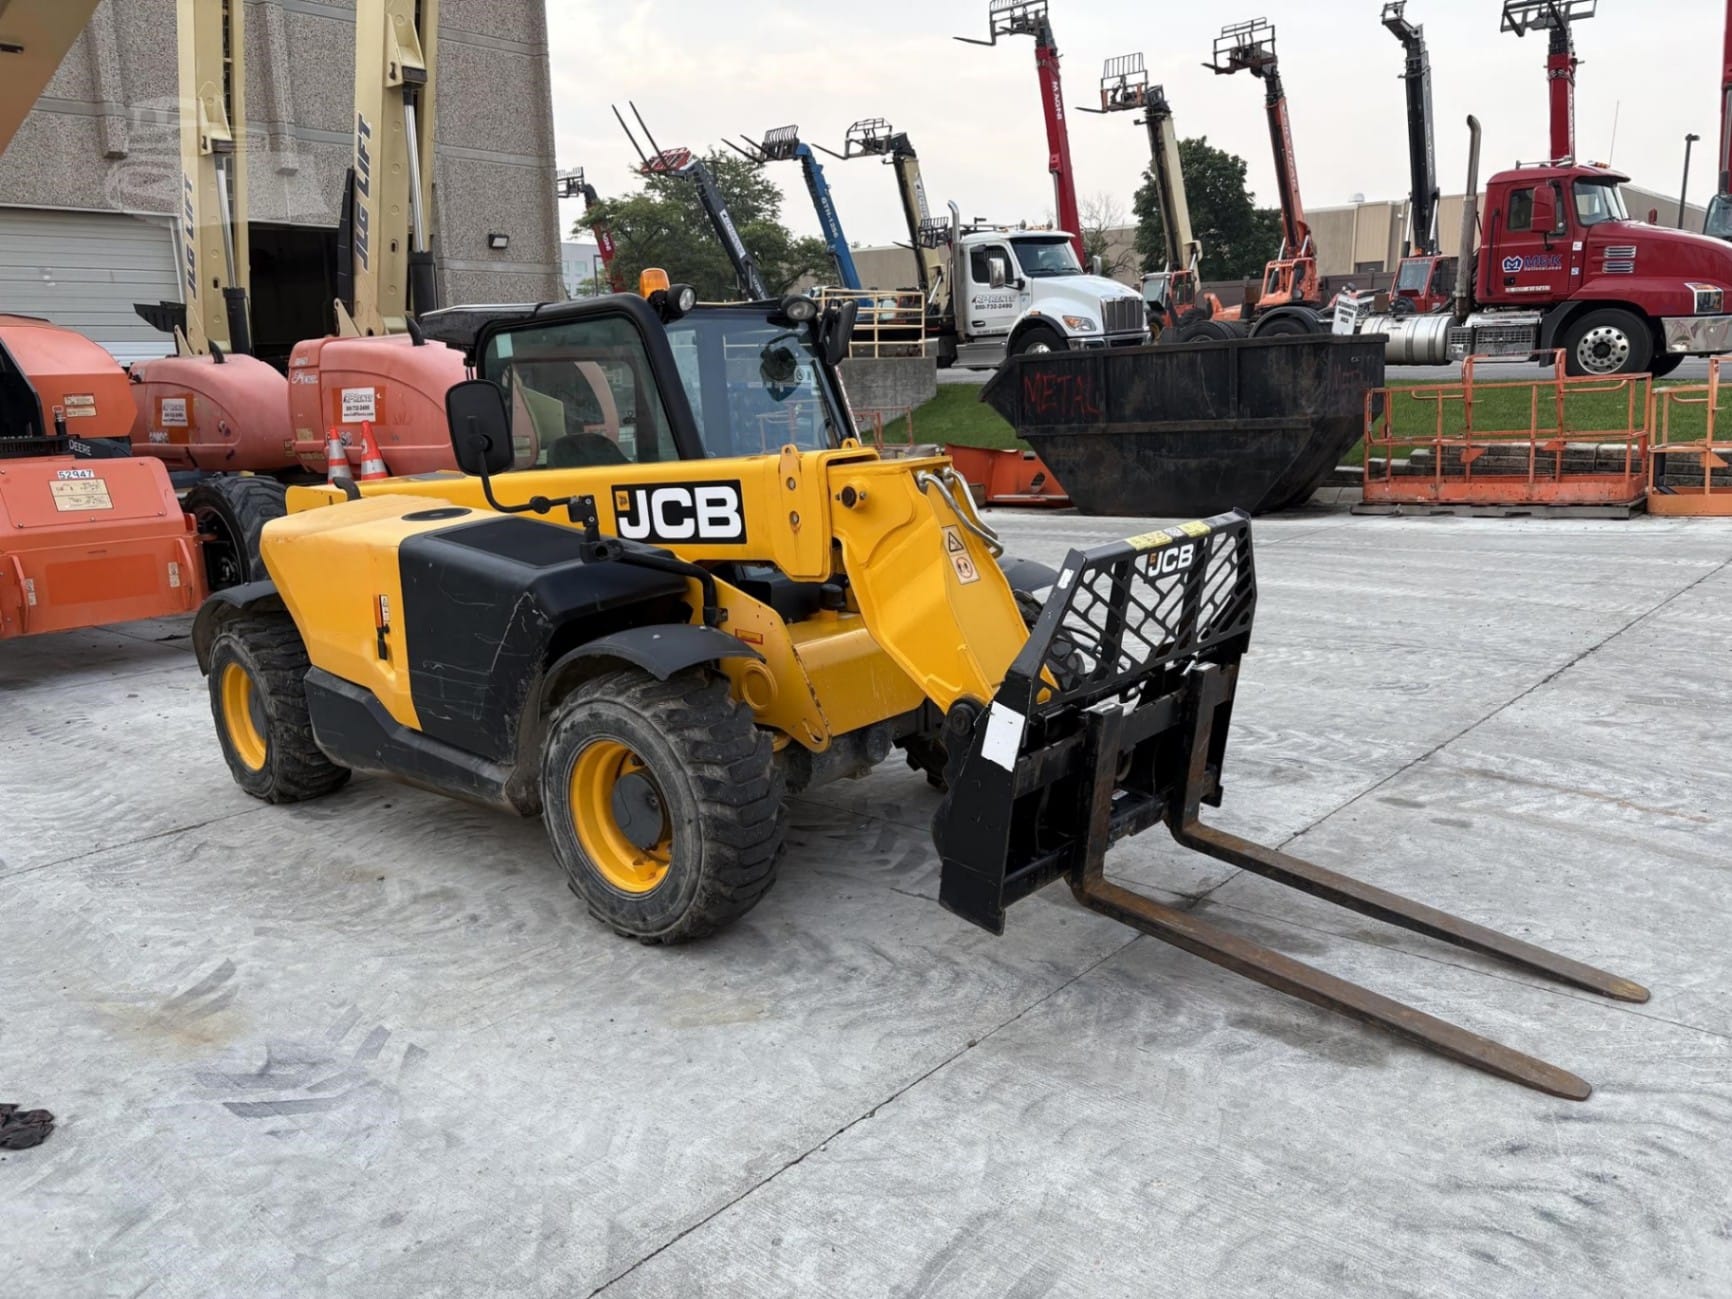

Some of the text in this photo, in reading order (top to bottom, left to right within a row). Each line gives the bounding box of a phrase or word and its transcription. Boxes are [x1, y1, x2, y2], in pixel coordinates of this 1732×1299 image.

[356, 112, 371, 272] JLG LIFT
[1024, 371, 1103, 417] METAL
[58, 470, 92, 479] 52947
[618, 486, 742, 539] JCB
[1148, 544, 1194, 577] JCB
